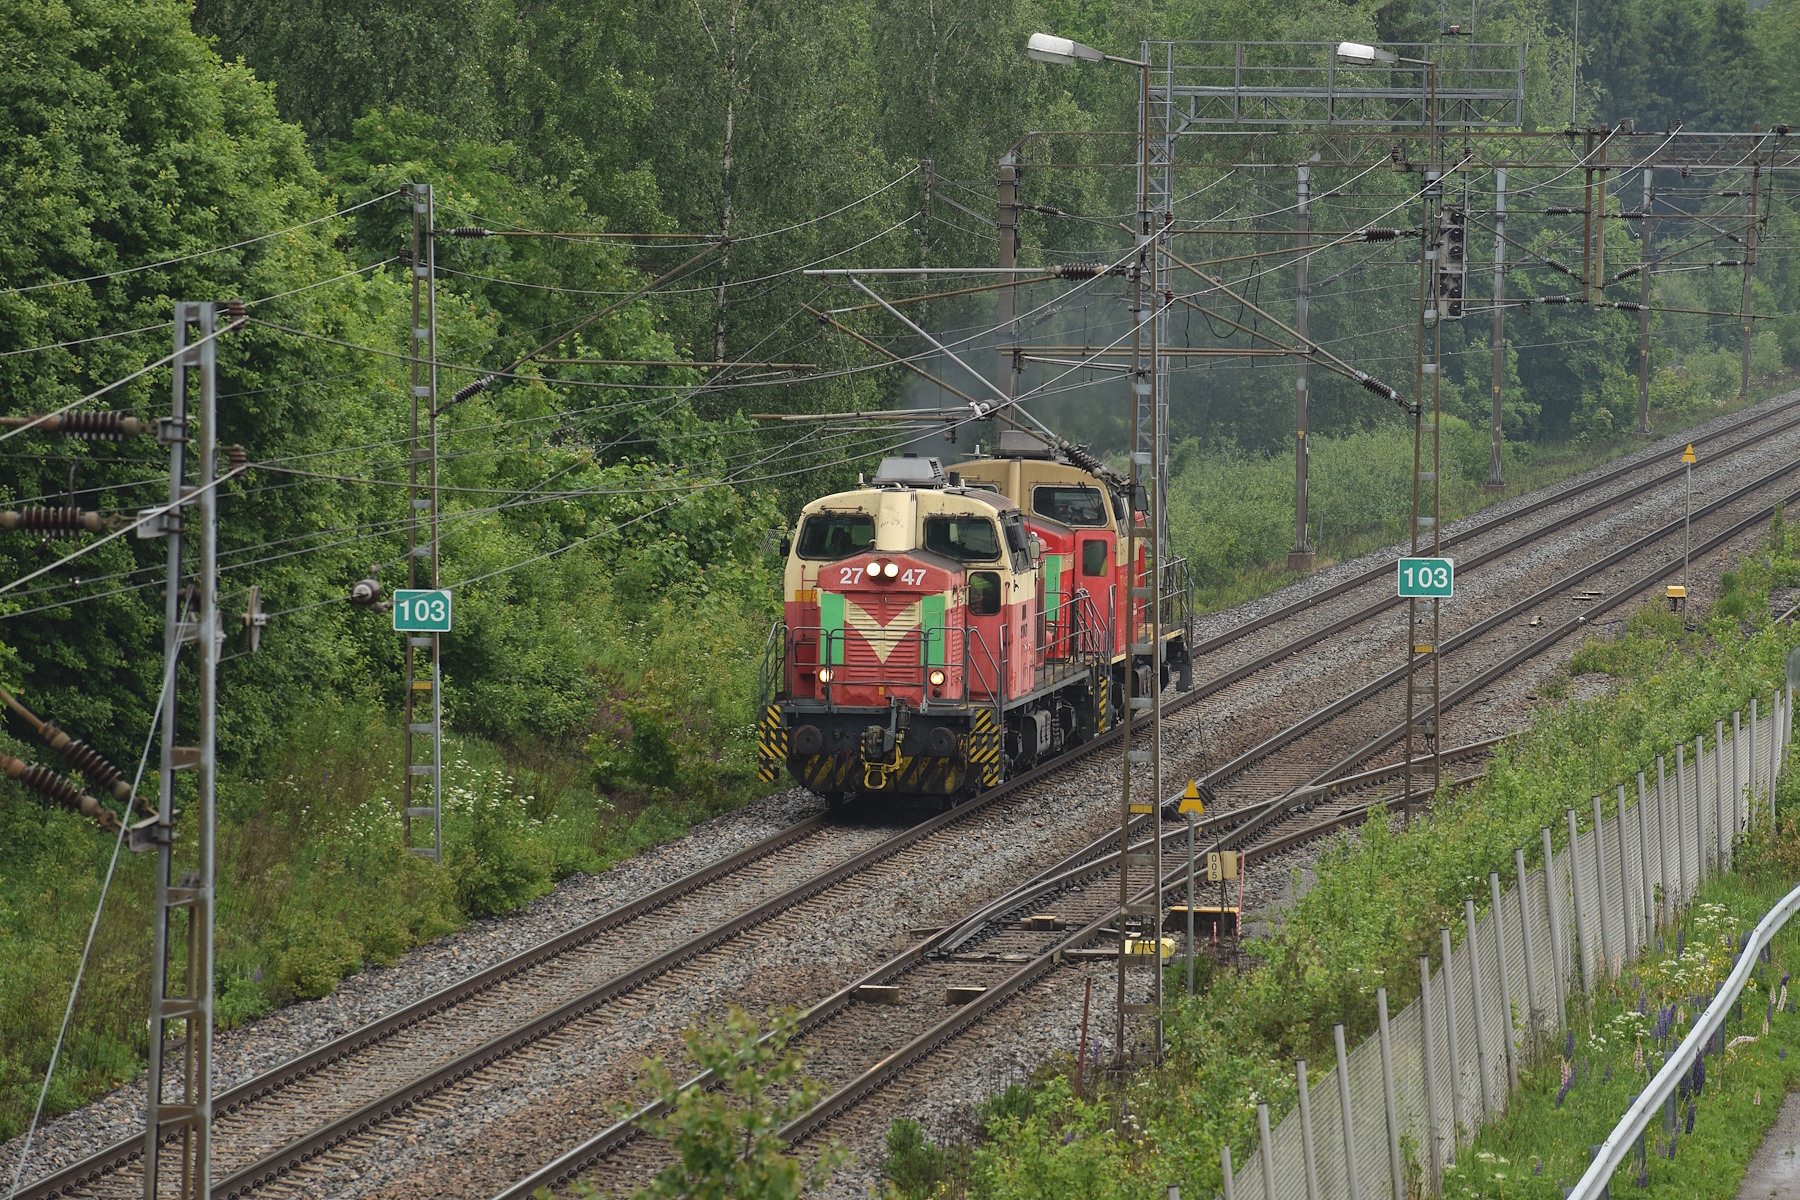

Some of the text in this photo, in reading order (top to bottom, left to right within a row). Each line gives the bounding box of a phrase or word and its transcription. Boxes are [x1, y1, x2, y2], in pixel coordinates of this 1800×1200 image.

[840, 567, 927, 586] 27 47
[1403, 567, 1448, 588] 103
[399, 599, 446, 622] 103
